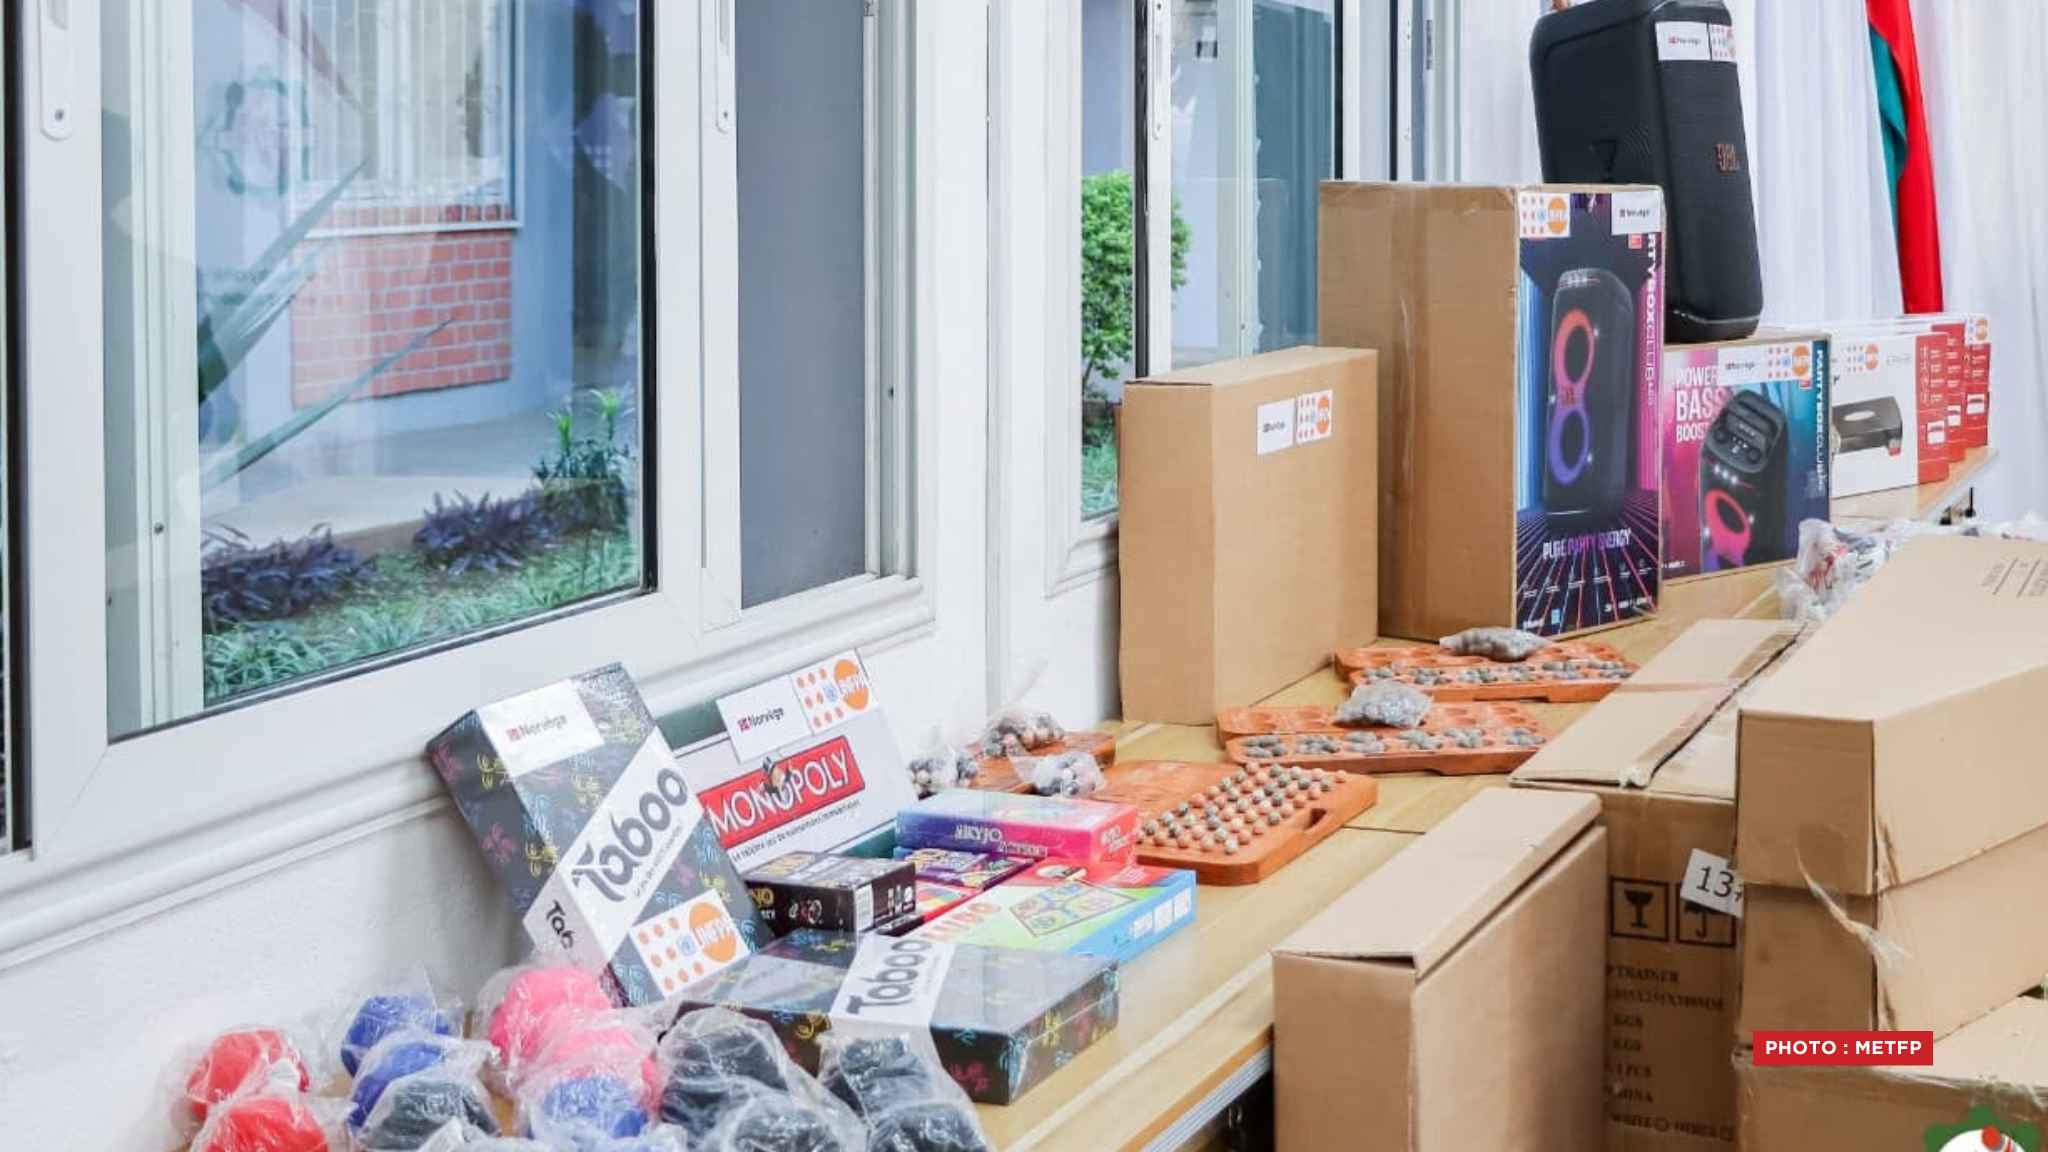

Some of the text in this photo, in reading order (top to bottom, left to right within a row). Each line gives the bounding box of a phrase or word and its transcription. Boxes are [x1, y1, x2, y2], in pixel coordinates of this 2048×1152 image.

[571, 767, 688, 902] Taboo
[706, 747, 849, 836] MONOPOLY
[846, 940, 932, 1014] Taboo
